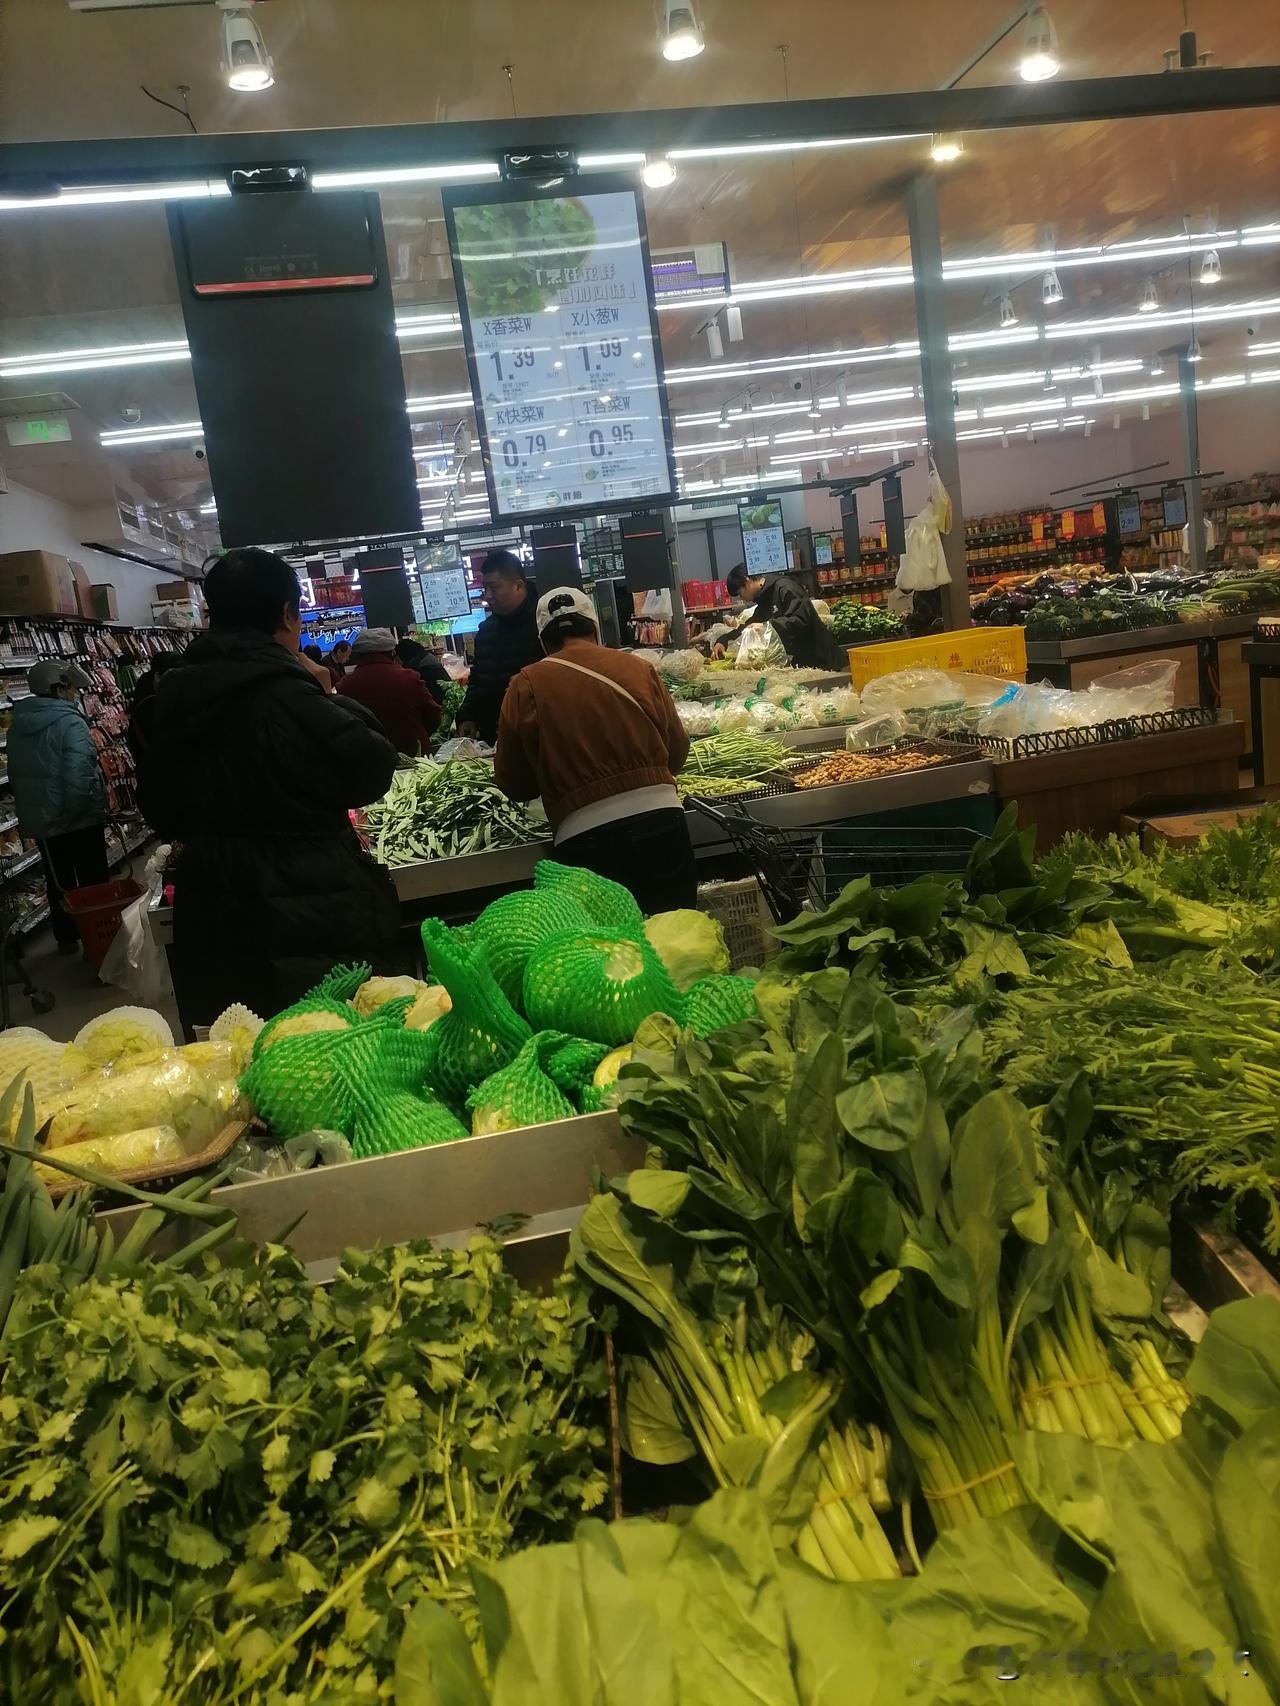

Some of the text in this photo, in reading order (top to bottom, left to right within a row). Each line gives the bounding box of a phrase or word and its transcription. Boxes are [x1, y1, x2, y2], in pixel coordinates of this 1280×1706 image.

[483, 317, 532, 336] X香菜W
[572, 307, 619, 327] X小葱W
[490, 346, 535, 381] 1.39
[578, 337, 622, 371] 1.09
[496, 406, 545, 425] K快菜W
[502, 434, 547, 468] 0.79
[589, 424, 634, 458] 0.95
